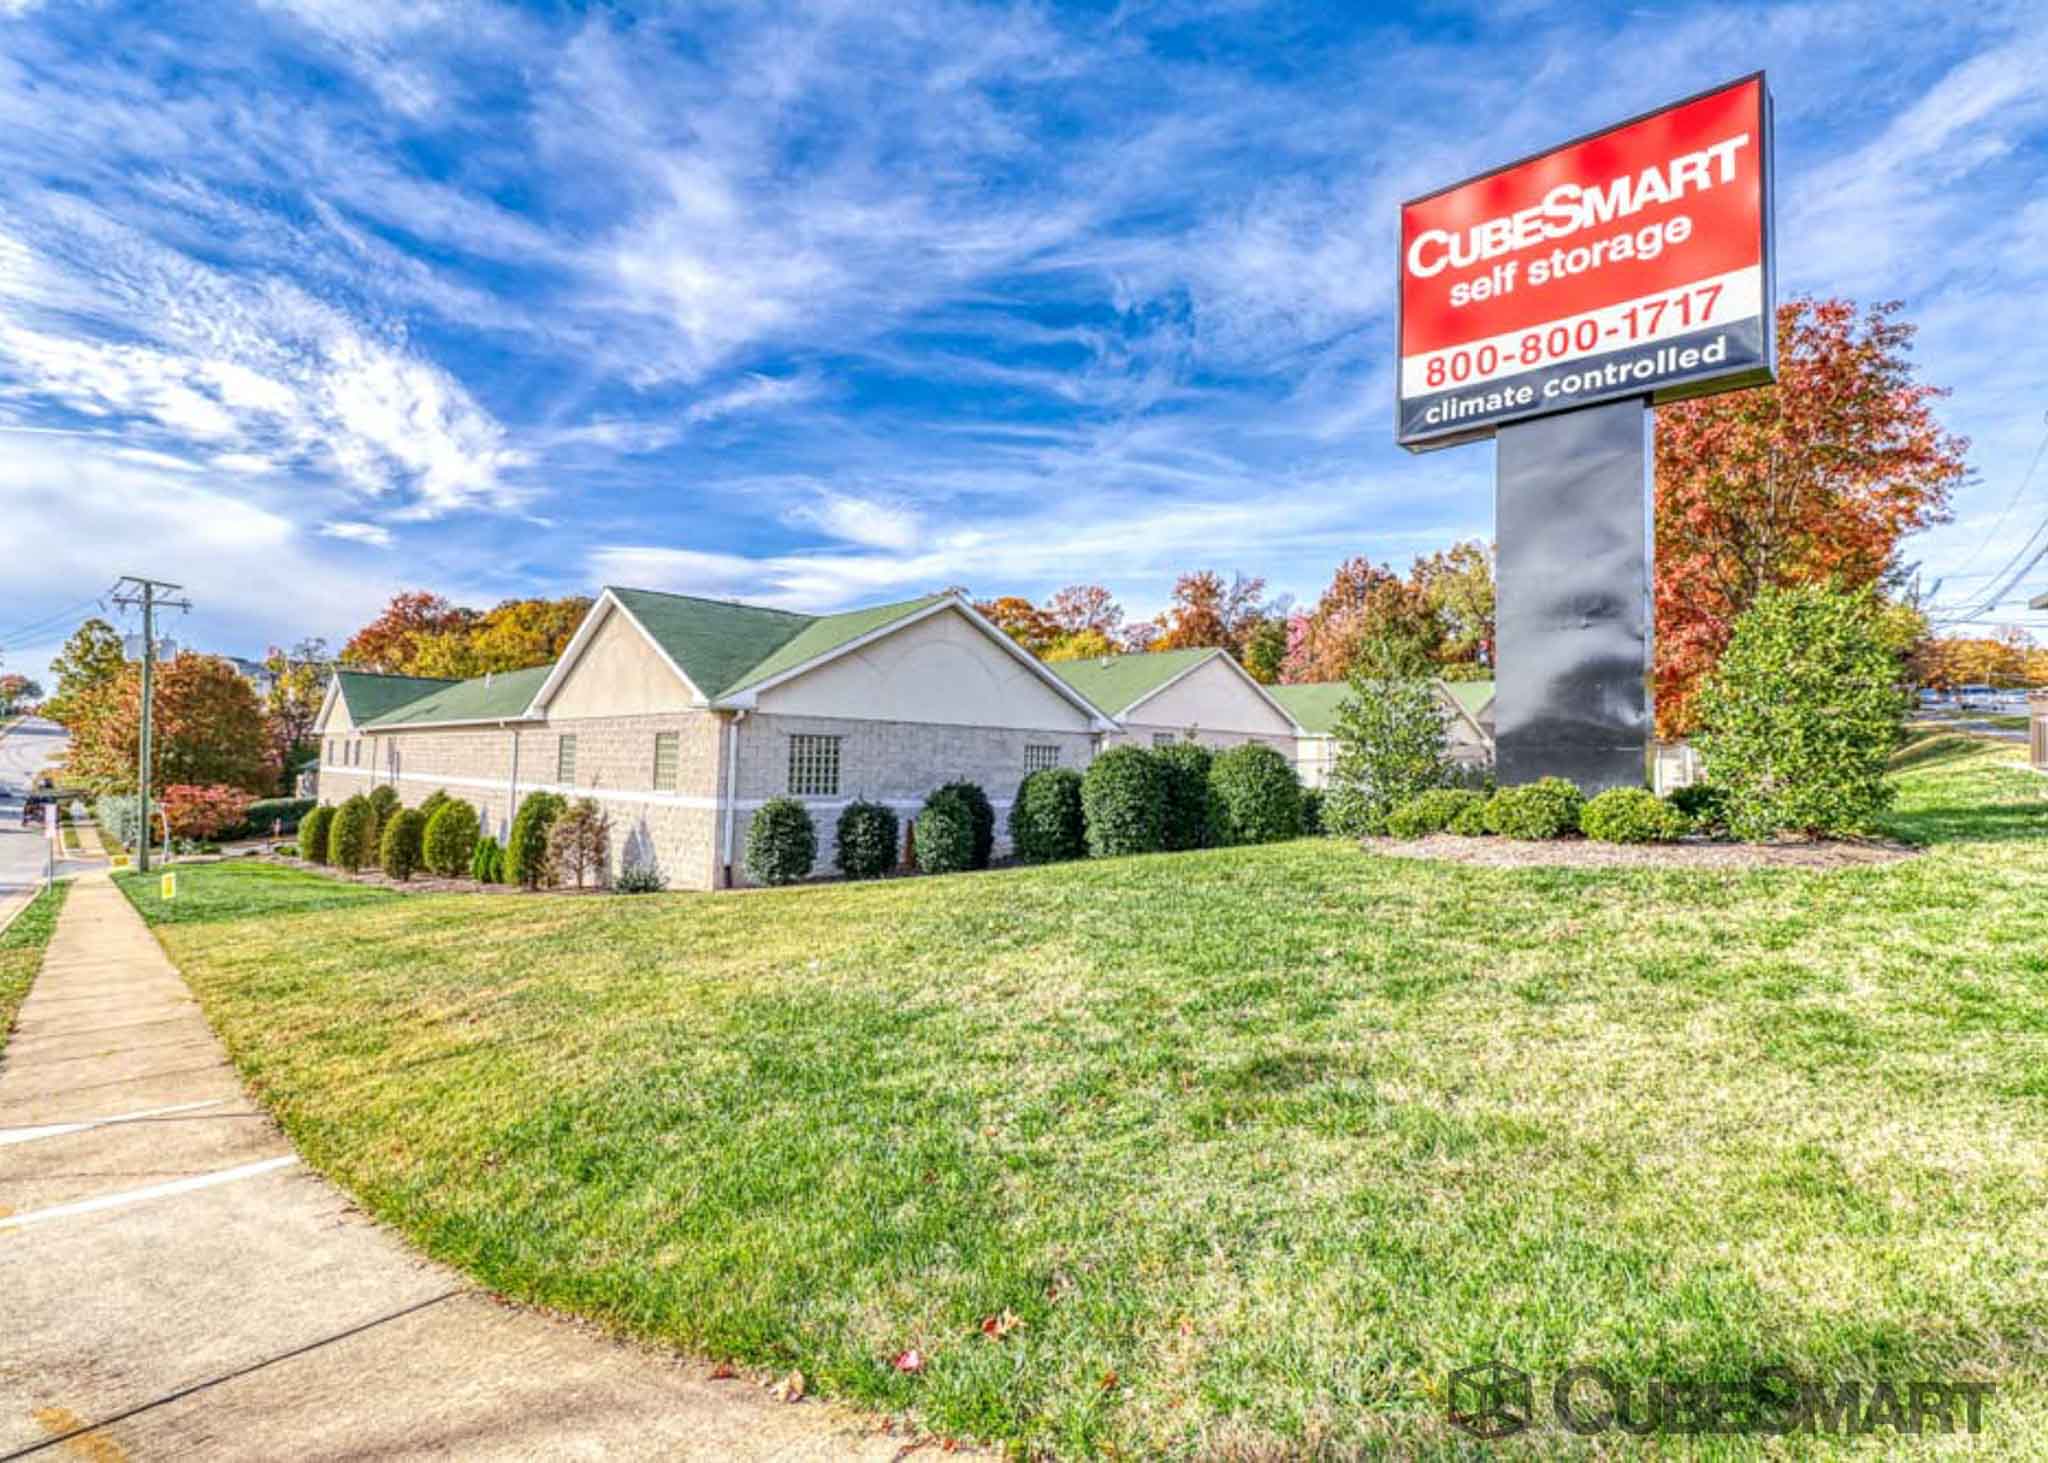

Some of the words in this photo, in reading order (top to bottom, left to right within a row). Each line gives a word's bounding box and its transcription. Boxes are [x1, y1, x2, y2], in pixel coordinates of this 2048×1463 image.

[1407, 133, 1750, 278] CUBESMART
[1450, 261, 1517, 307] self
[1527, 215, 1693, 285] storage
[1425, 382, 1535, 424] climate
[1543, 335, 1727, 398] controlled
[1426, 283, 1724, 388] 800-800-1717
